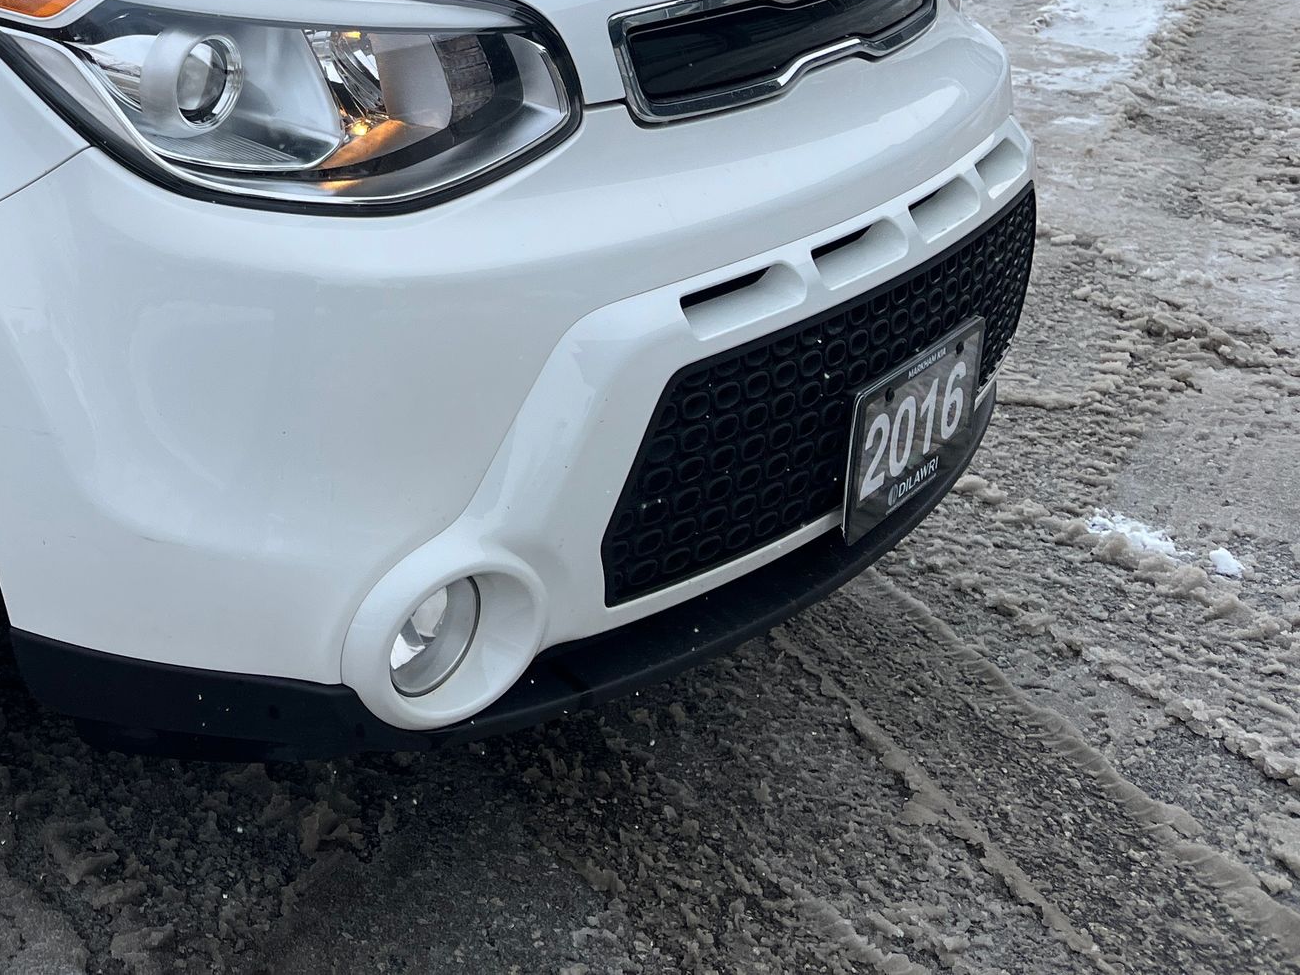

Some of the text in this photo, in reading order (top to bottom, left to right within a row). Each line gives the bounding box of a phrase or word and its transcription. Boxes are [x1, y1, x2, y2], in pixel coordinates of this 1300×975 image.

[907, 347, 946, 380] MARKHAM KIA
[859, 361, 966, 502] 2016
[898, 455, 939, 498] DILAWRI
